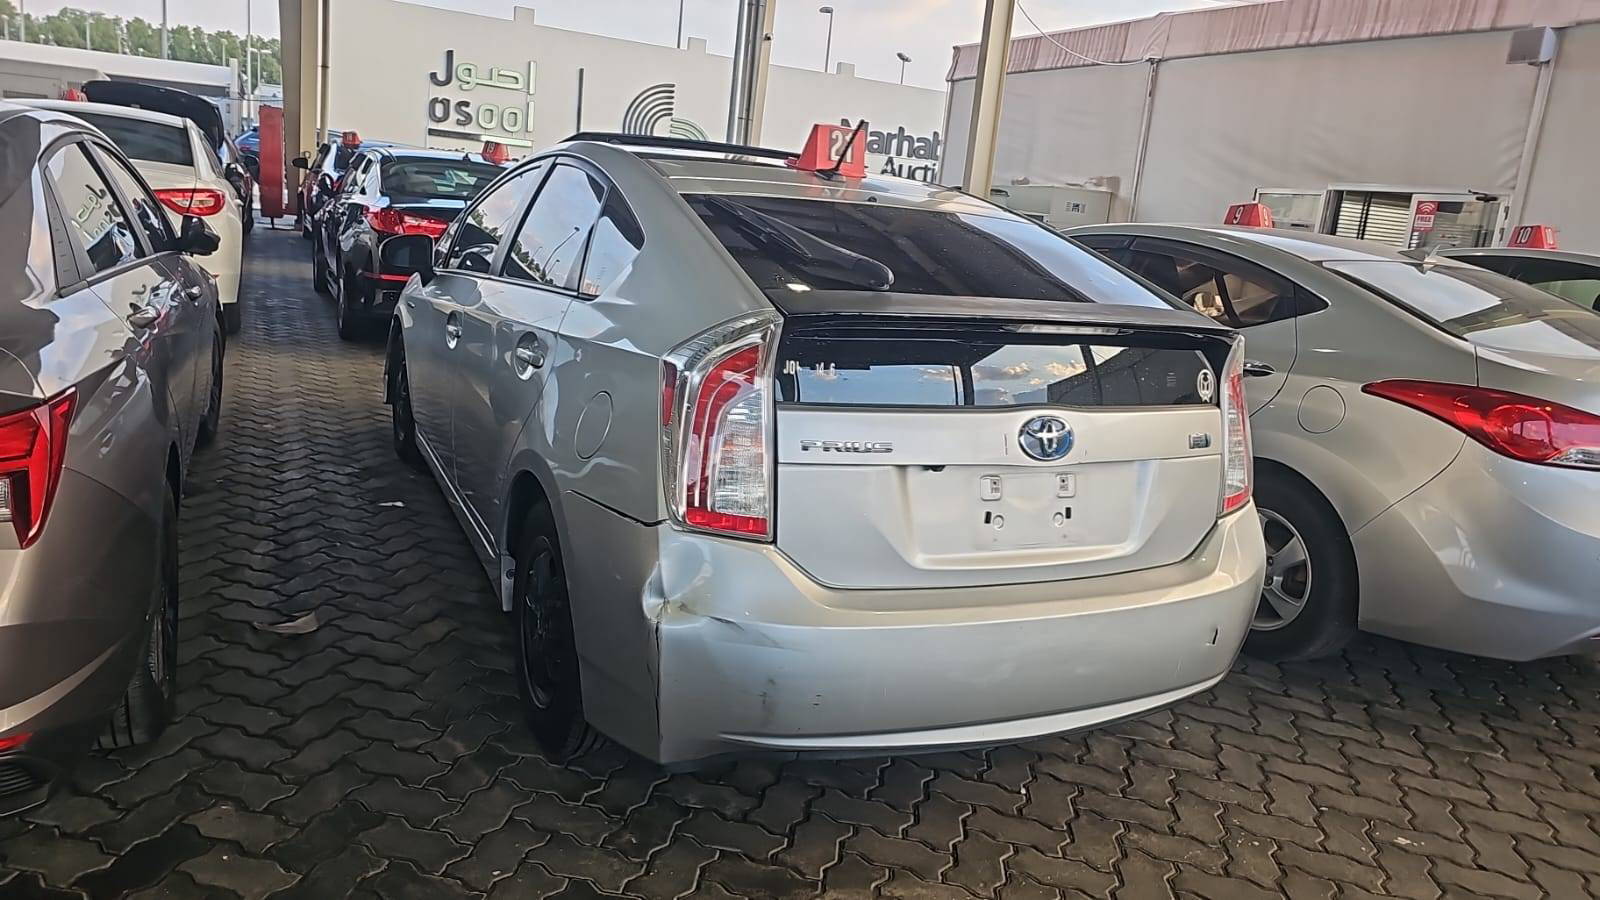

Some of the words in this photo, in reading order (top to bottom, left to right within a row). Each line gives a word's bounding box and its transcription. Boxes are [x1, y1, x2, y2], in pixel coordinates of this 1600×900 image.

[429, 49, 537, 95] اصول
[830, 129, 854, 163] 21
[1232, 206, 1244, 224] 9
[1516, 227, 1532, 244] 10
[800, 440, 893, 453] PRIUS
